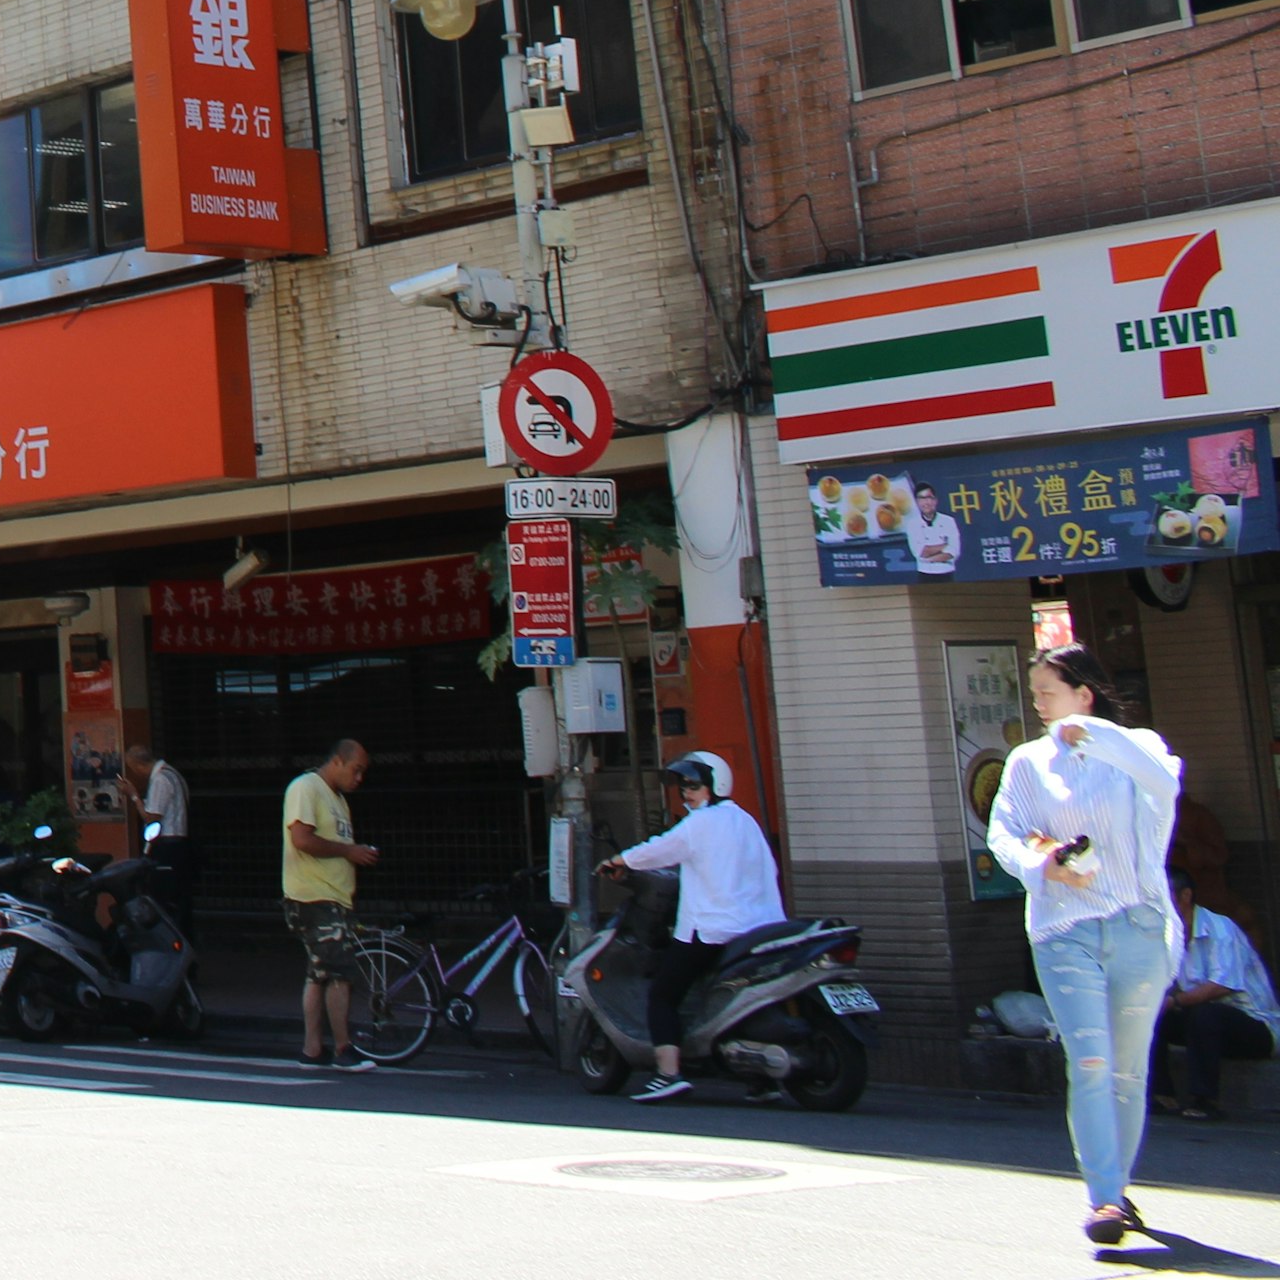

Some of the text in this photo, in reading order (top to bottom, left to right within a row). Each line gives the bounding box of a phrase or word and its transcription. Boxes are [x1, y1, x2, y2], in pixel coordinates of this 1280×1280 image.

[182, 96, 272, 141] 萬華分行
[210, 165, 256, 188] TAIWAN
[190, 192, 279, 223] BUSINESS BANK
[1107, 228, 1224, 400] 7
[948, 468, 1117, 526] 中秋禮盒
